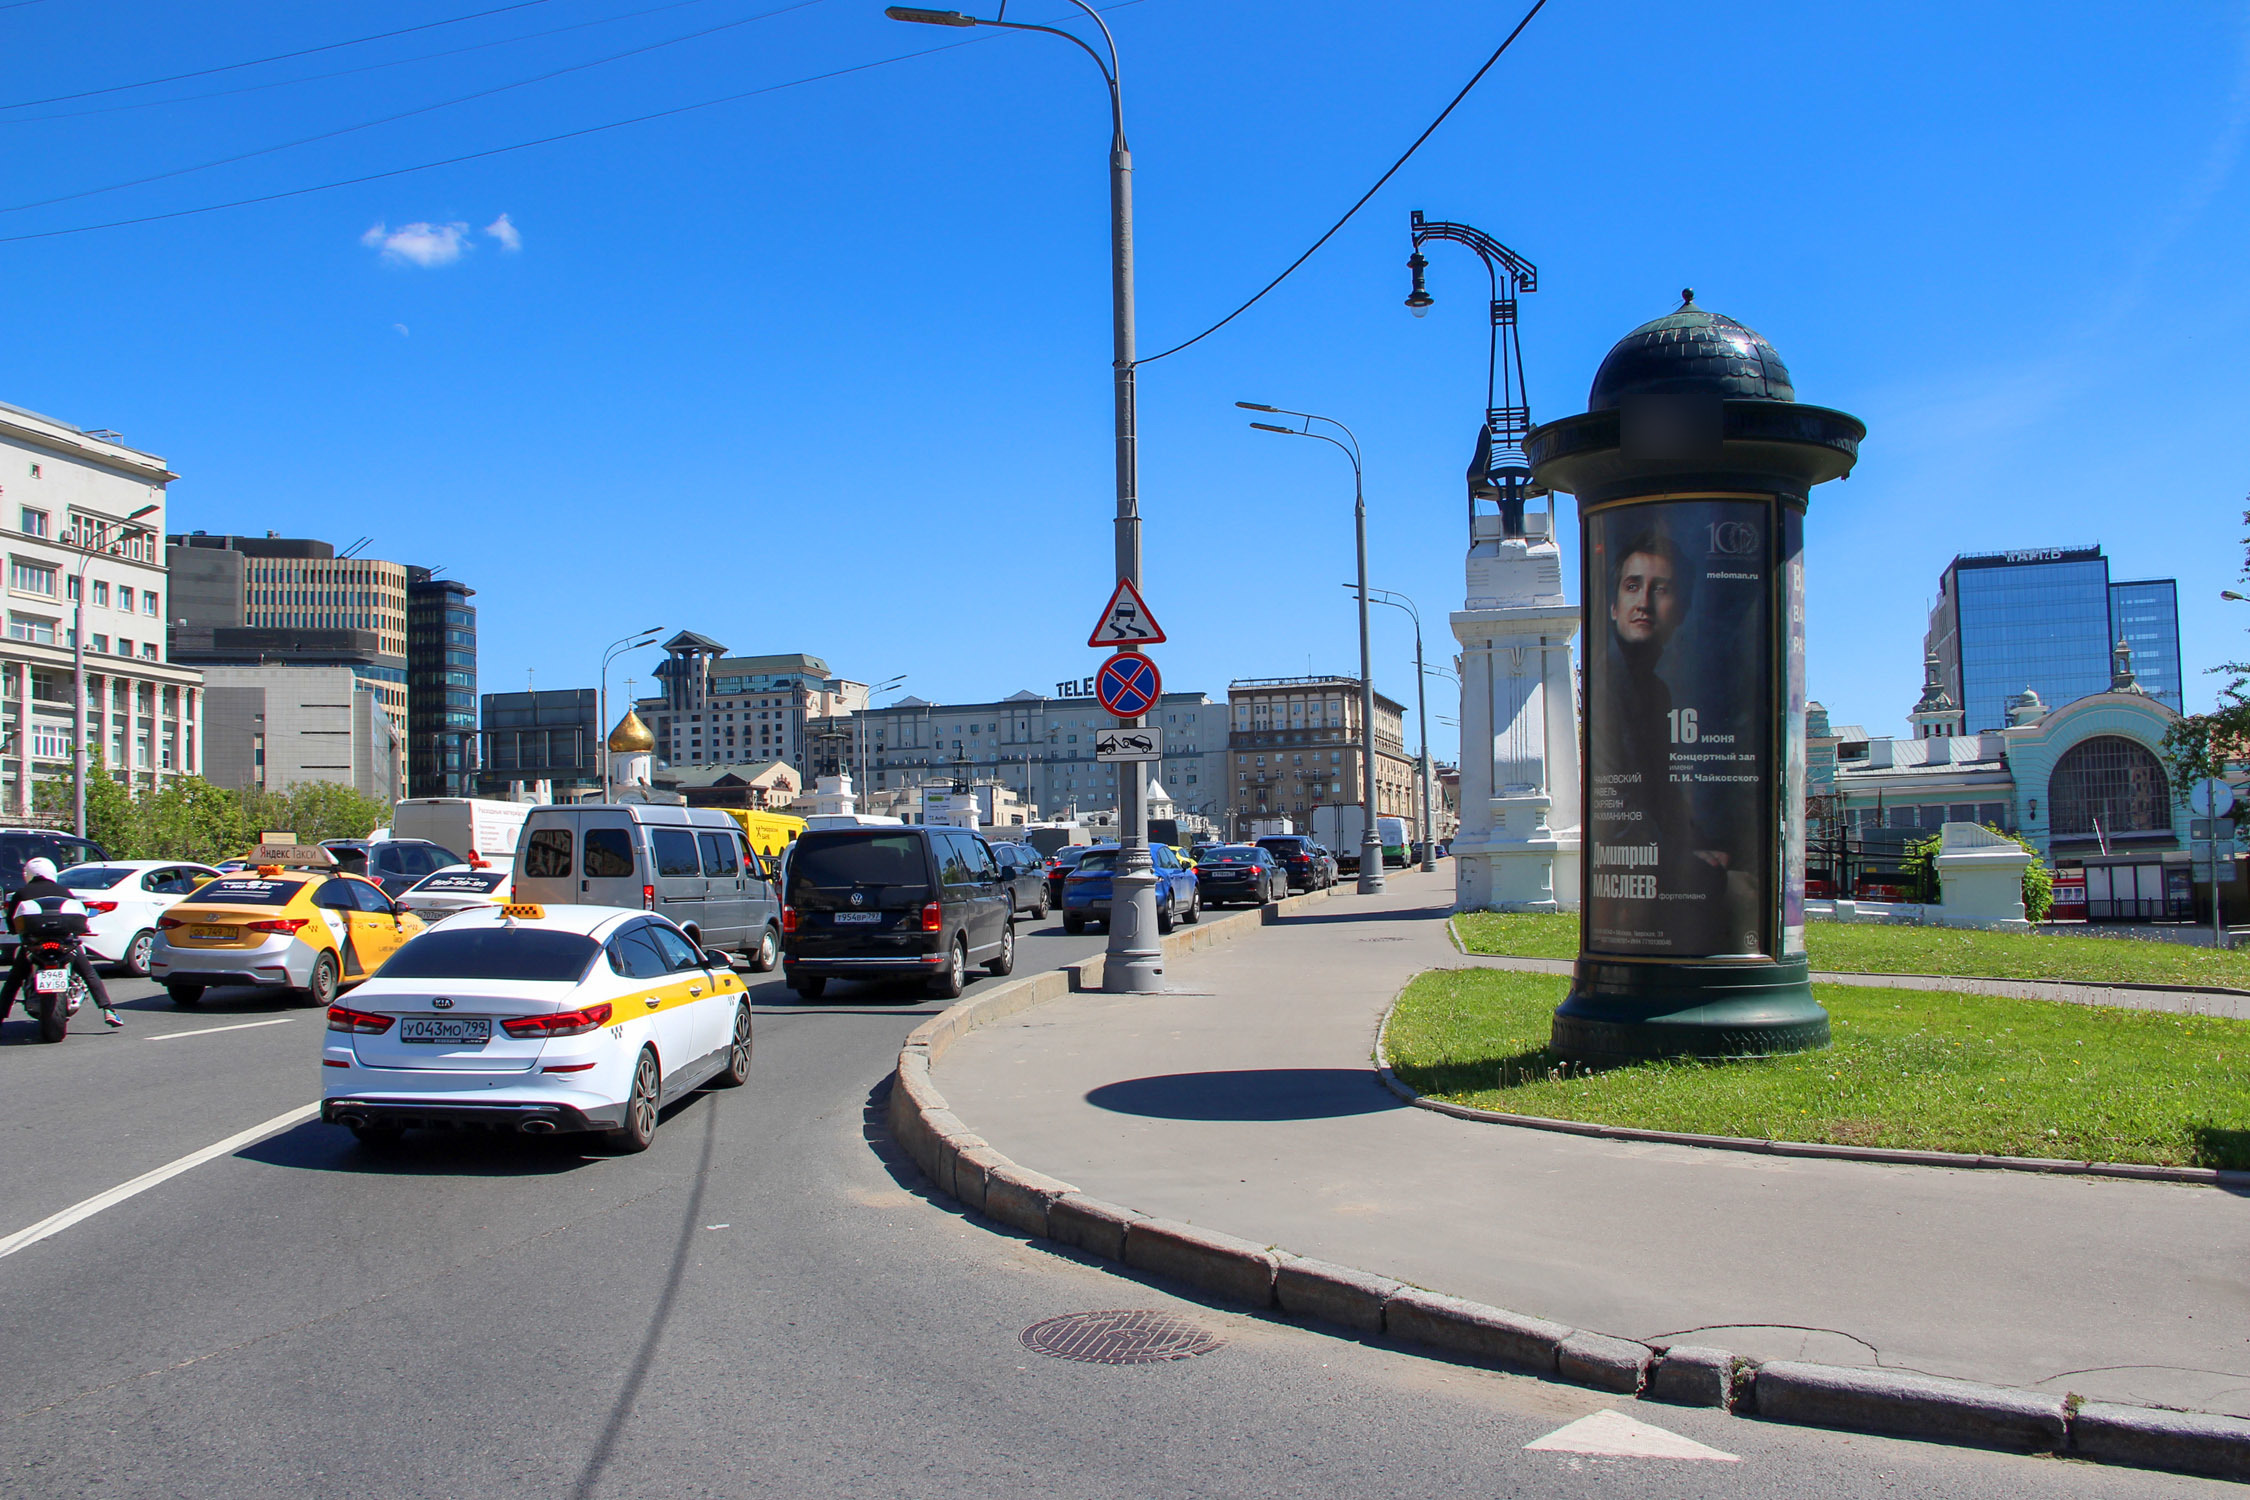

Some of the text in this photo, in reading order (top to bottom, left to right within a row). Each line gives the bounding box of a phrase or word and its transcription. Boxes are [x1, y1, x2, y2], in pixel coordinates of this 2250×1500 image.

[1706, 571, 1759, 580] meloman.ru
[1667, 707, 1735, 744] 16 июня
[1669, 752, 1736, 762] Концертный
[1694, 773, 1760, 782] Чайковского
[260, 846, 317, 860] Яндекс Такси
[1593, 841, 1659, 870] Дмитрий
[1593, 873, 1706, 902] МАСЛЕЕВ фортепиано
[41, 971, 64, 979] 5948
[39, 980, 66, 989] АУ 50
[434, 999, 452, 1007] KIA
[407, 1021, 486, 1037] У043МО 799
